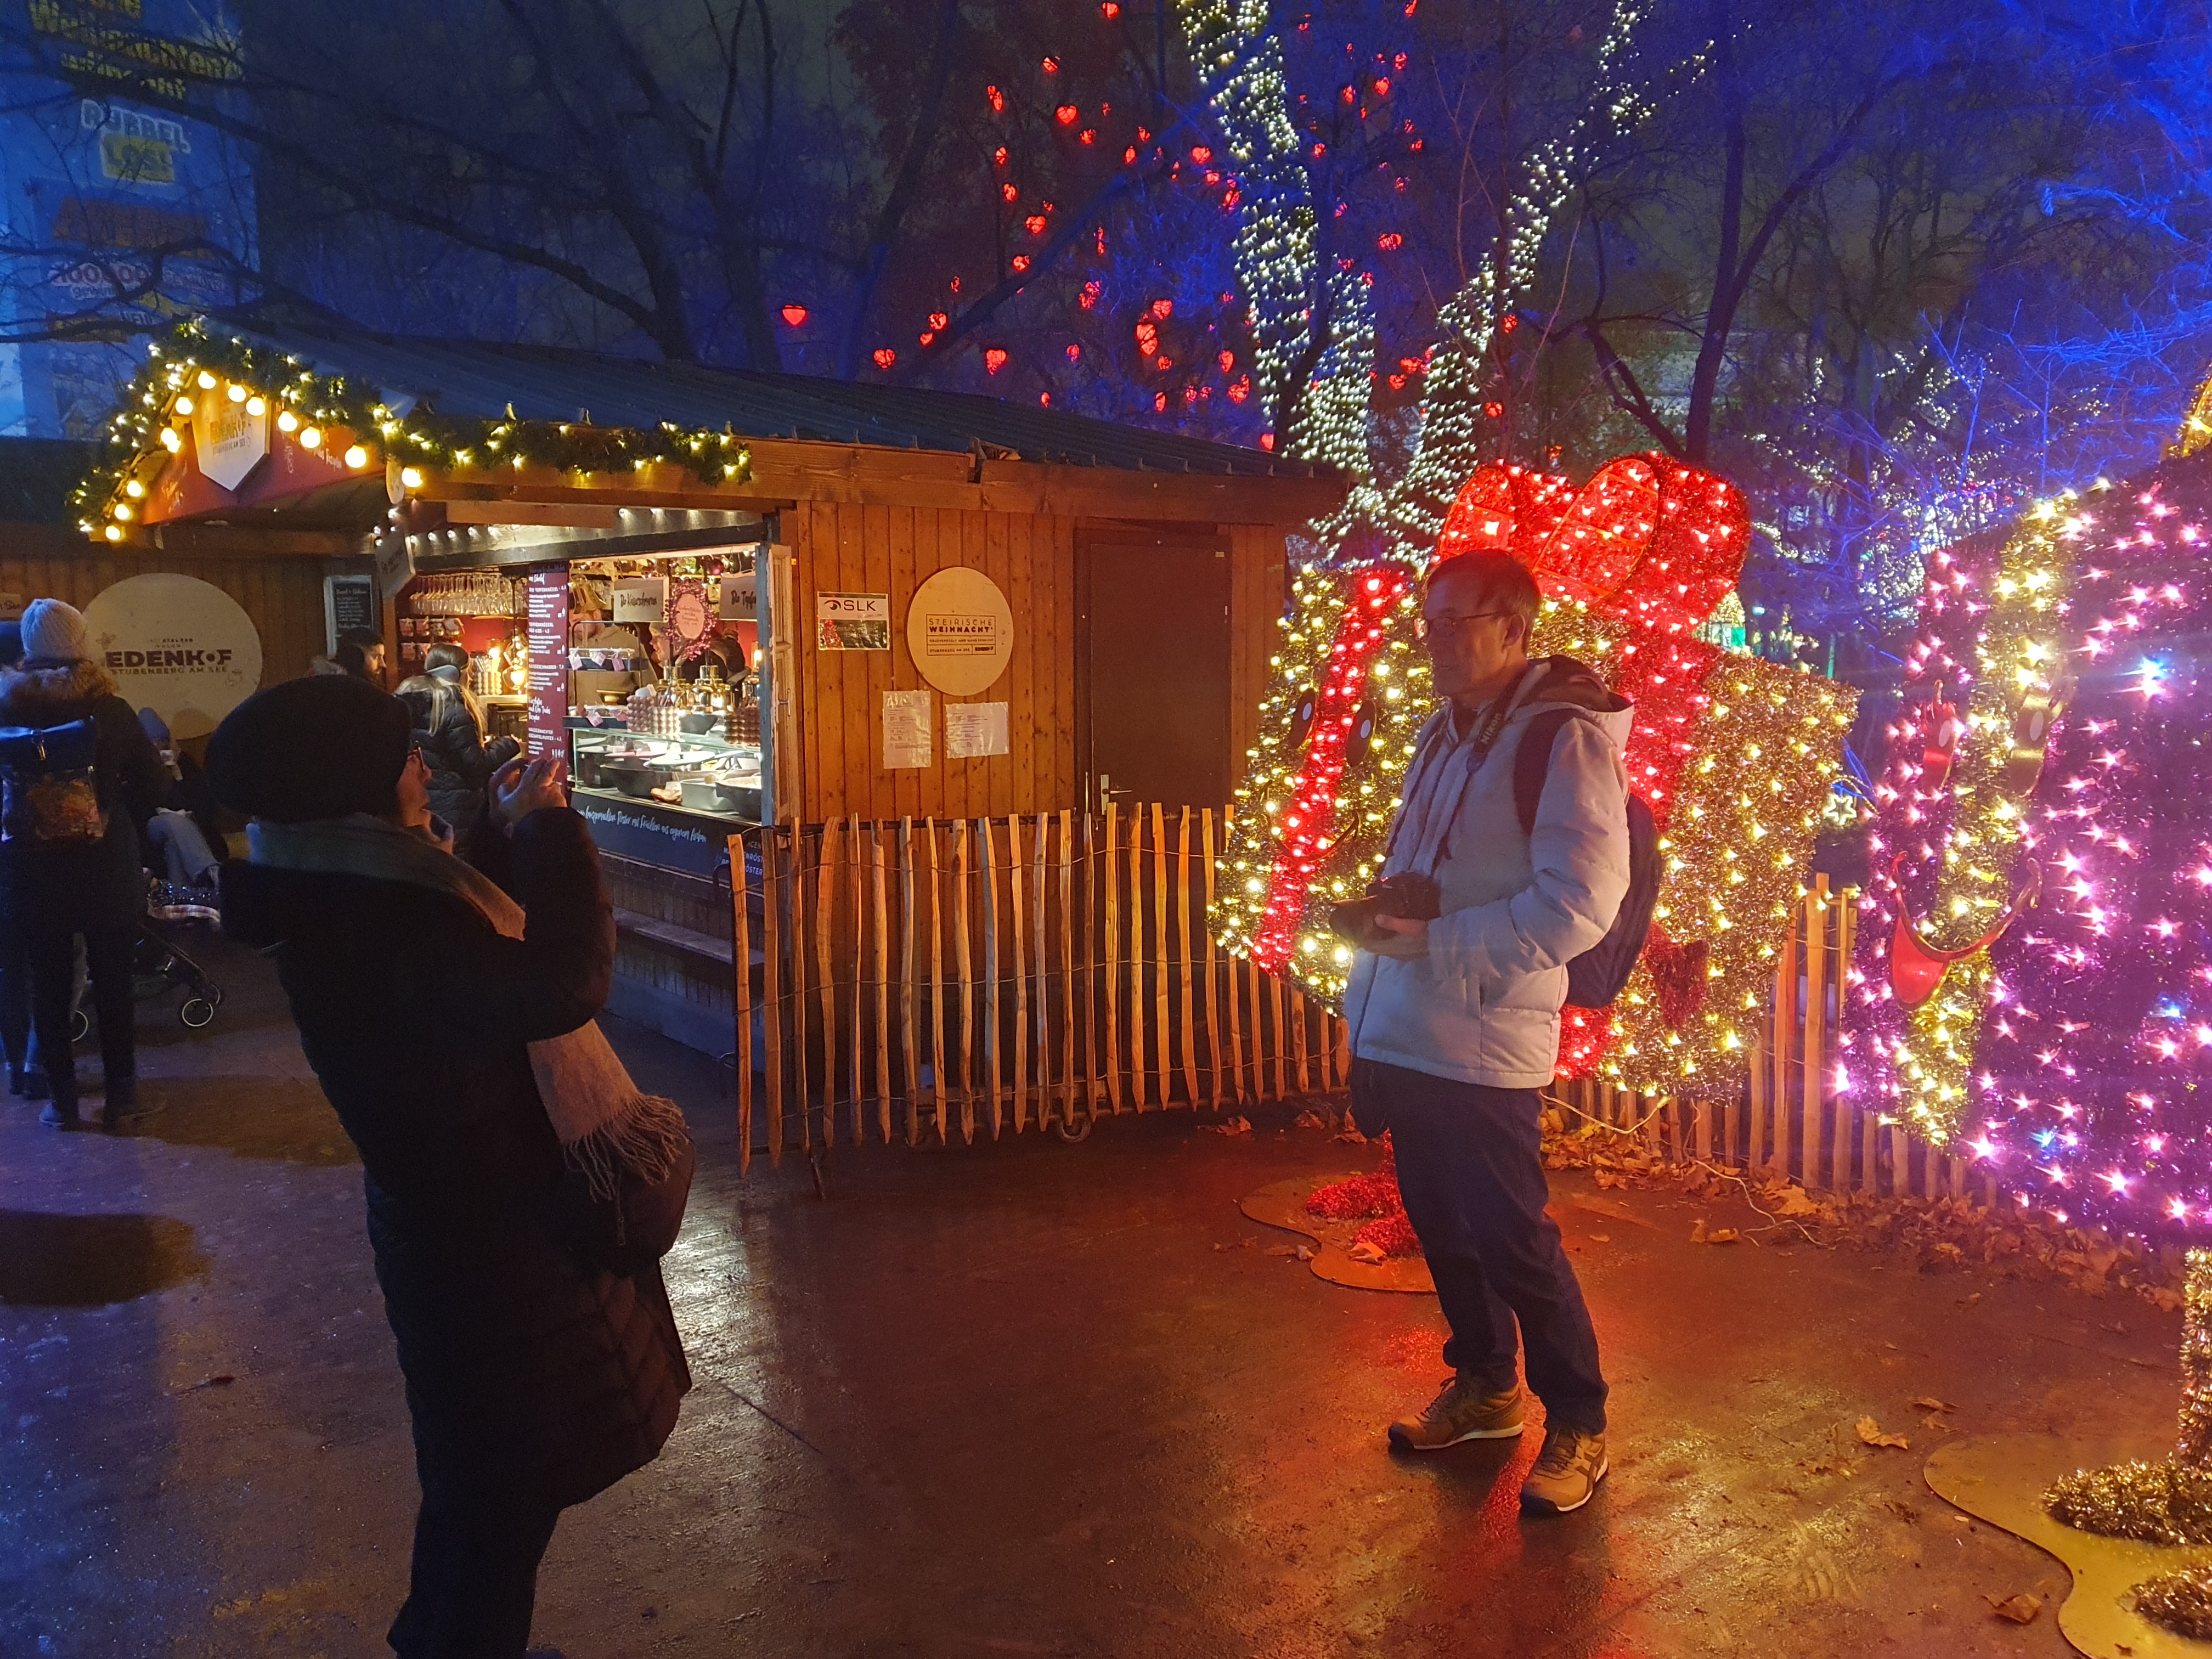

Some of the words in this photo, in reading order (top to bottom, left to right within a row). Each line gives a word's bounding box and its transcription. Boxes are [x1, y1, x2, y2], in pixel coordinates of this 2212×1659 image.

[844, 600, 876, 612] SLK
[929, 618, 992, 626] STEIRISCHE
[1481, 713, 1502, 744] Nikon
